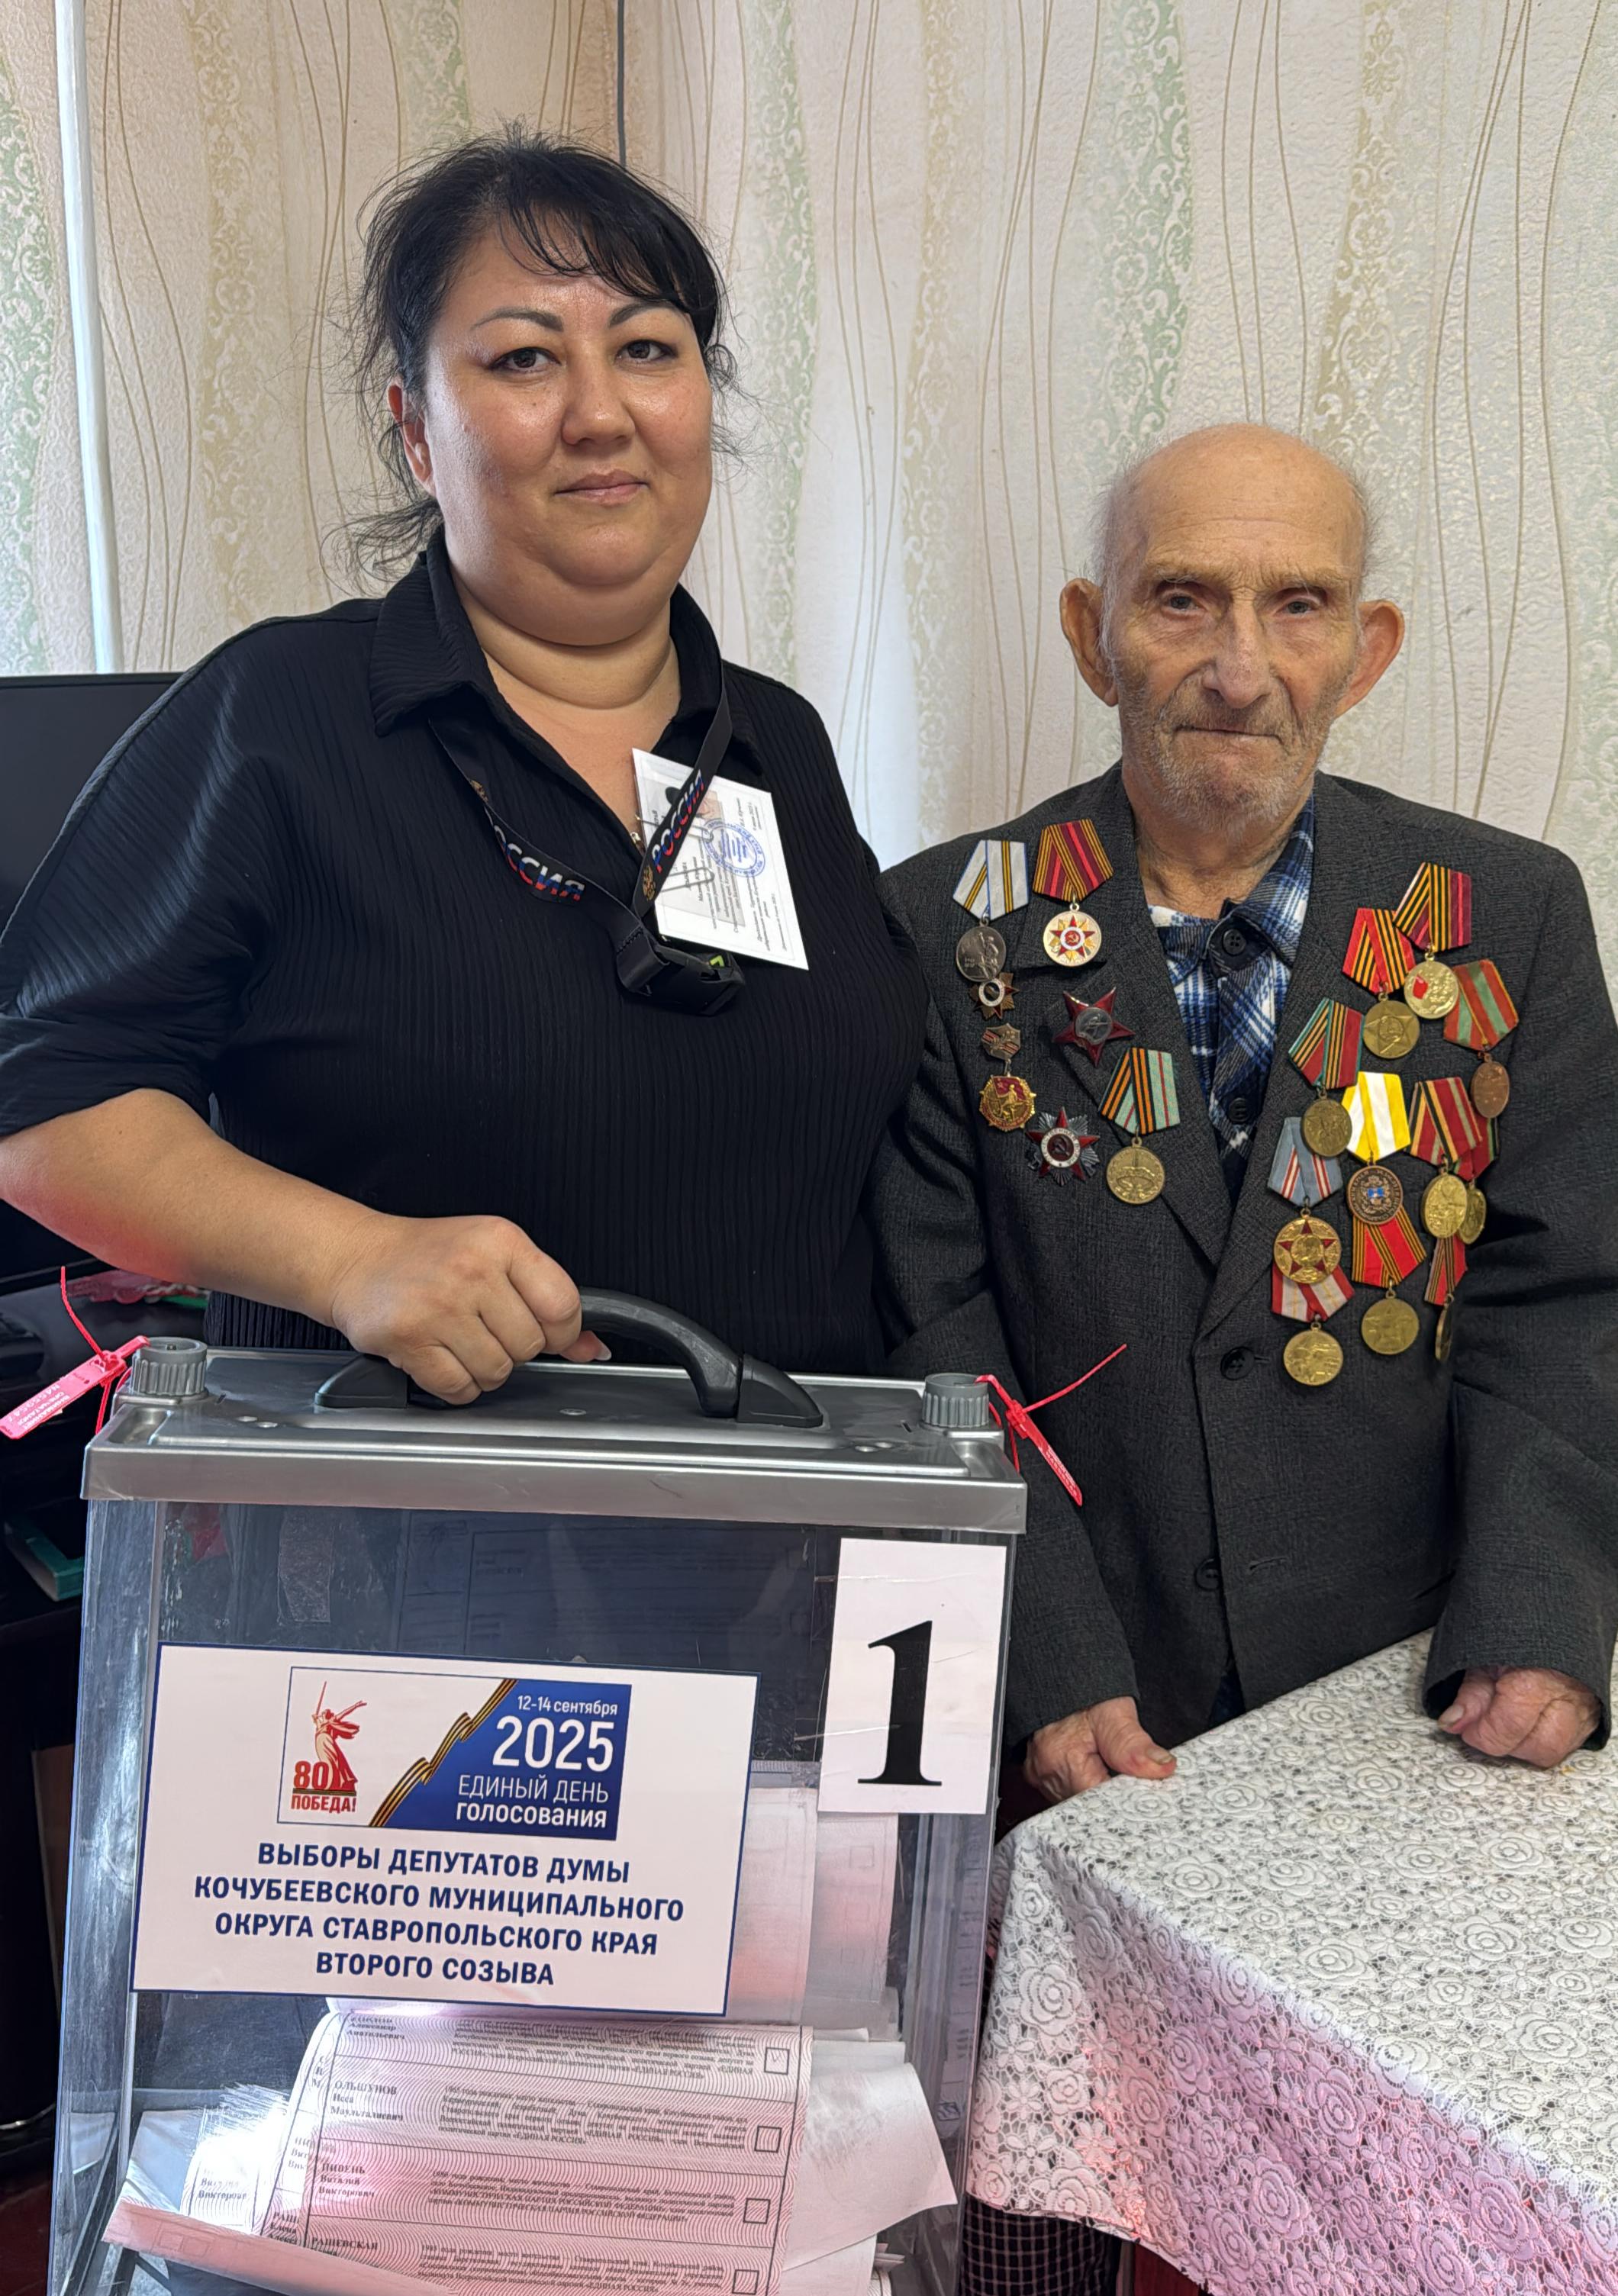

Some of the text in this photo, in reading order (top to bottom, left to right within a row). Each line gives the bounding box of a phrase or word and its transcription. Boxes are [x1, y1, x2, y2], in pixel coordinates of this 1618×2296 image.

[652, 769, 704, 873] РОССИЯ
[517, 1695, 618, 1717] 12-14 сентября
[857, 1620, 943, 1786] 1
[492, 1715, 614, 1772] 2025
[294, 1760, 329, 1790] 80
[459, 1774, 609, 1804] ЕДИНЫЙ ДЕНЬ
[291, 1795, 356, 1814] ПОБЕДА!
[259, 1843, 630, 1884] ВЫБОРЫ ДЕПУТАТОВ ДУМЫ
[194, 1876, 684, 1921] КОЧУБЕЕВСКОГО МУНИЦИПАЛЬНОГО
[215, 1912, 657, 1955] ОКРУГА СТАВРОПОЛЬСКОГО КРАЯ
[316, 1952, 554, 1985] ВТОРОГО СОЗЫВА
